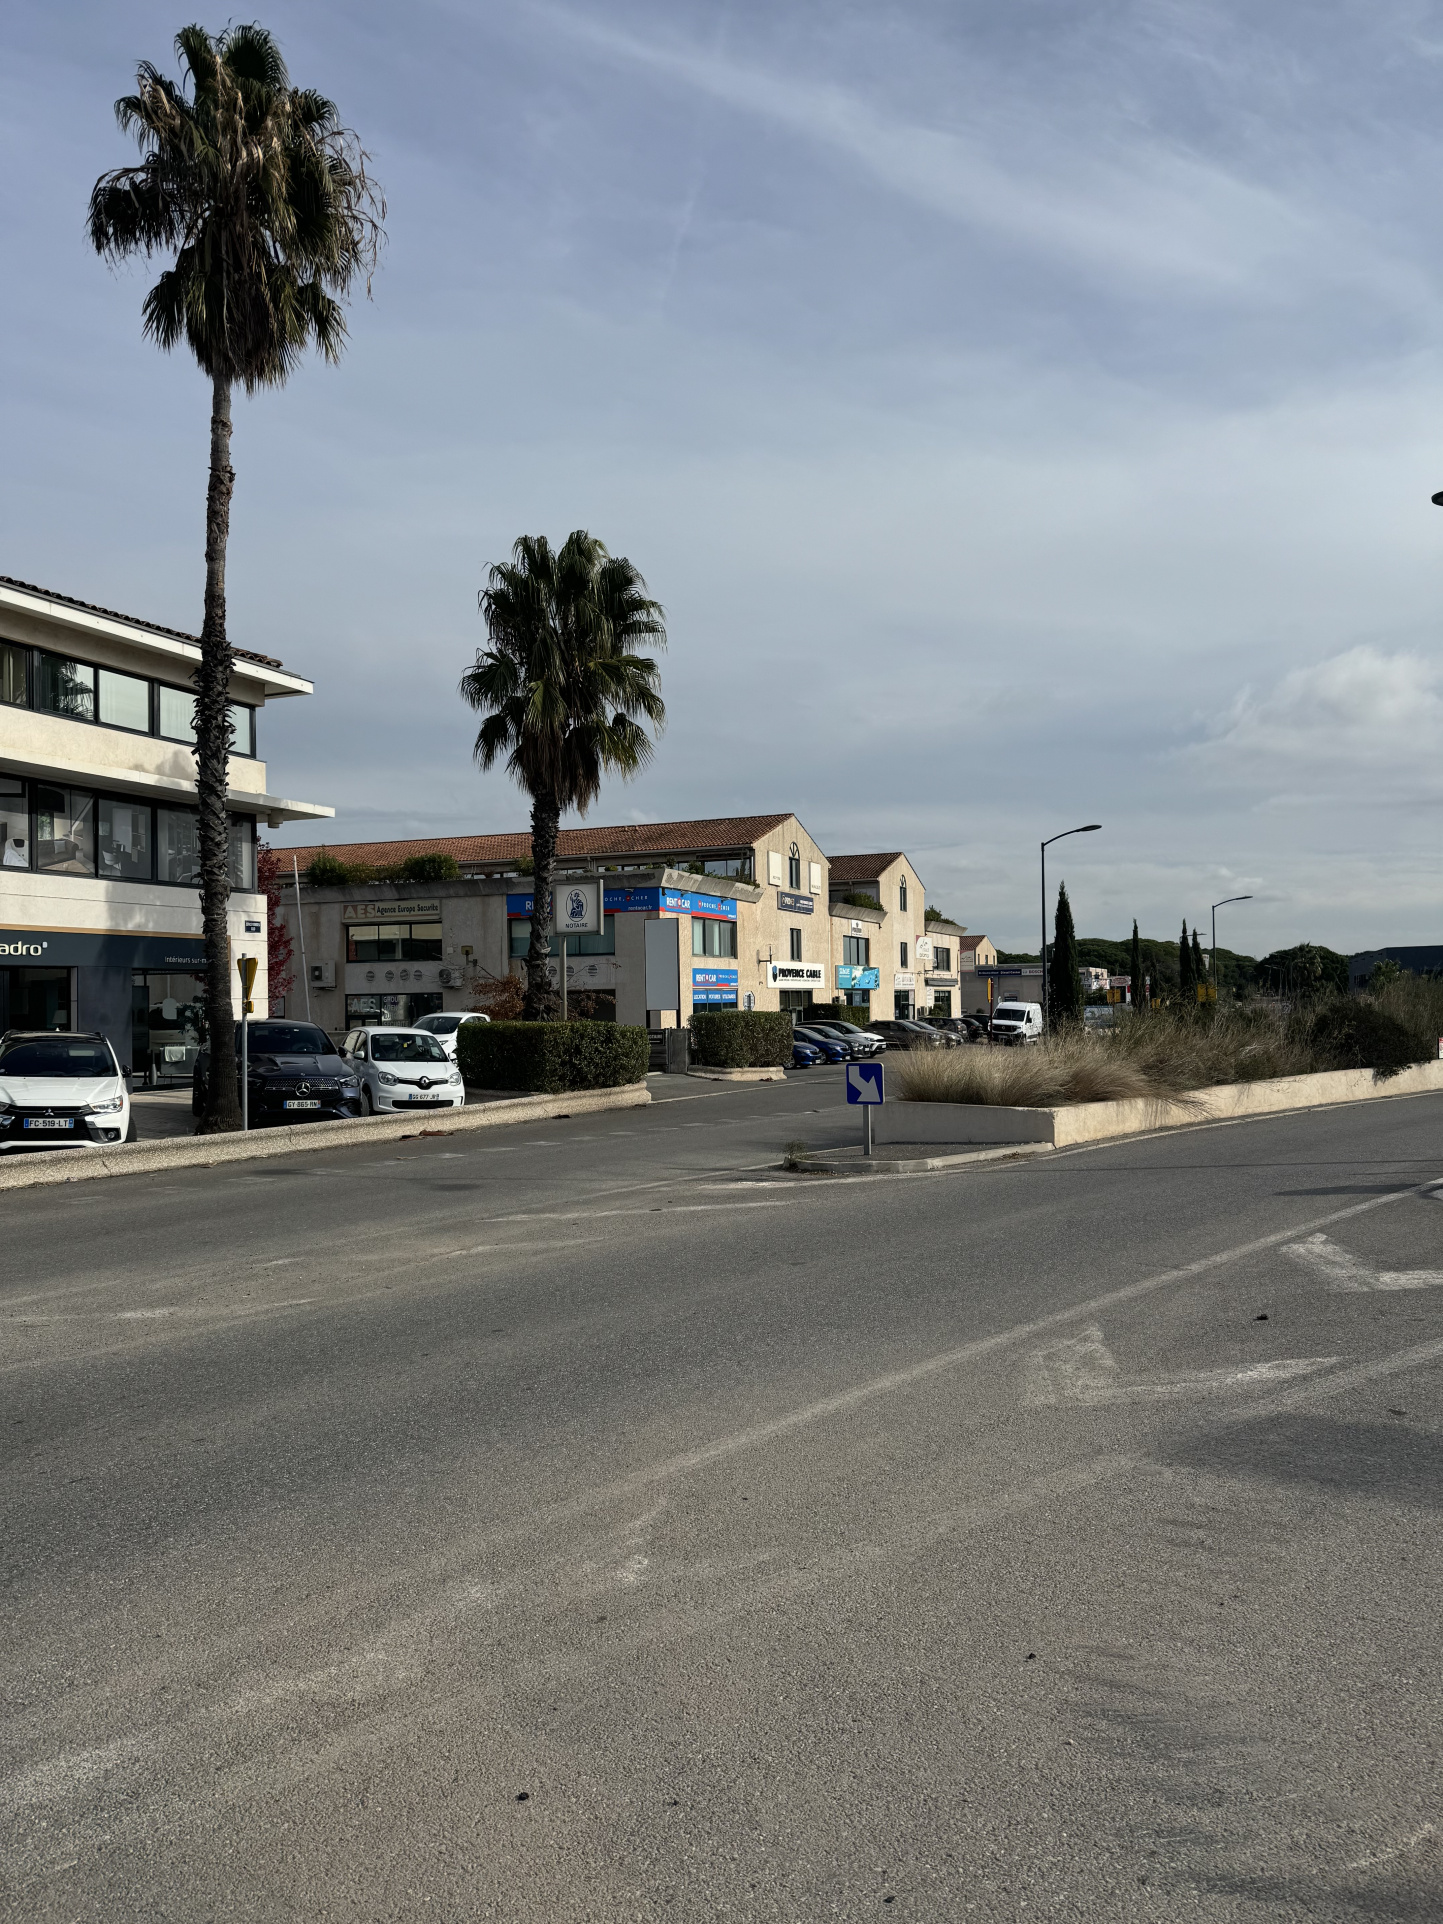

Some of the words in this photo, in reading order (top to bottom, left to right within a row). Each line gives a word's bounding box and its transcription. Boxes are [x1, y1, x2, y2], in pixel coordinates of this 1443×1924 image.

[666, 897, 678, 907] RENT
[681, 899, 691, 909] CAR
[344, 904, 375, 918] AES
[376, 905, 397, 915] Agence
[397, 904, 415, 914] Europe
[695, 974, 706, 982] RENT
[708, 974, 717, 982] CAR
[778, 967, 805, 979] PROVENCE
[805, 969, 822, 979] CABLE
[351, 997, 377, 1012] AES
[29, 1119, 69, 1128] FC-519-LT
